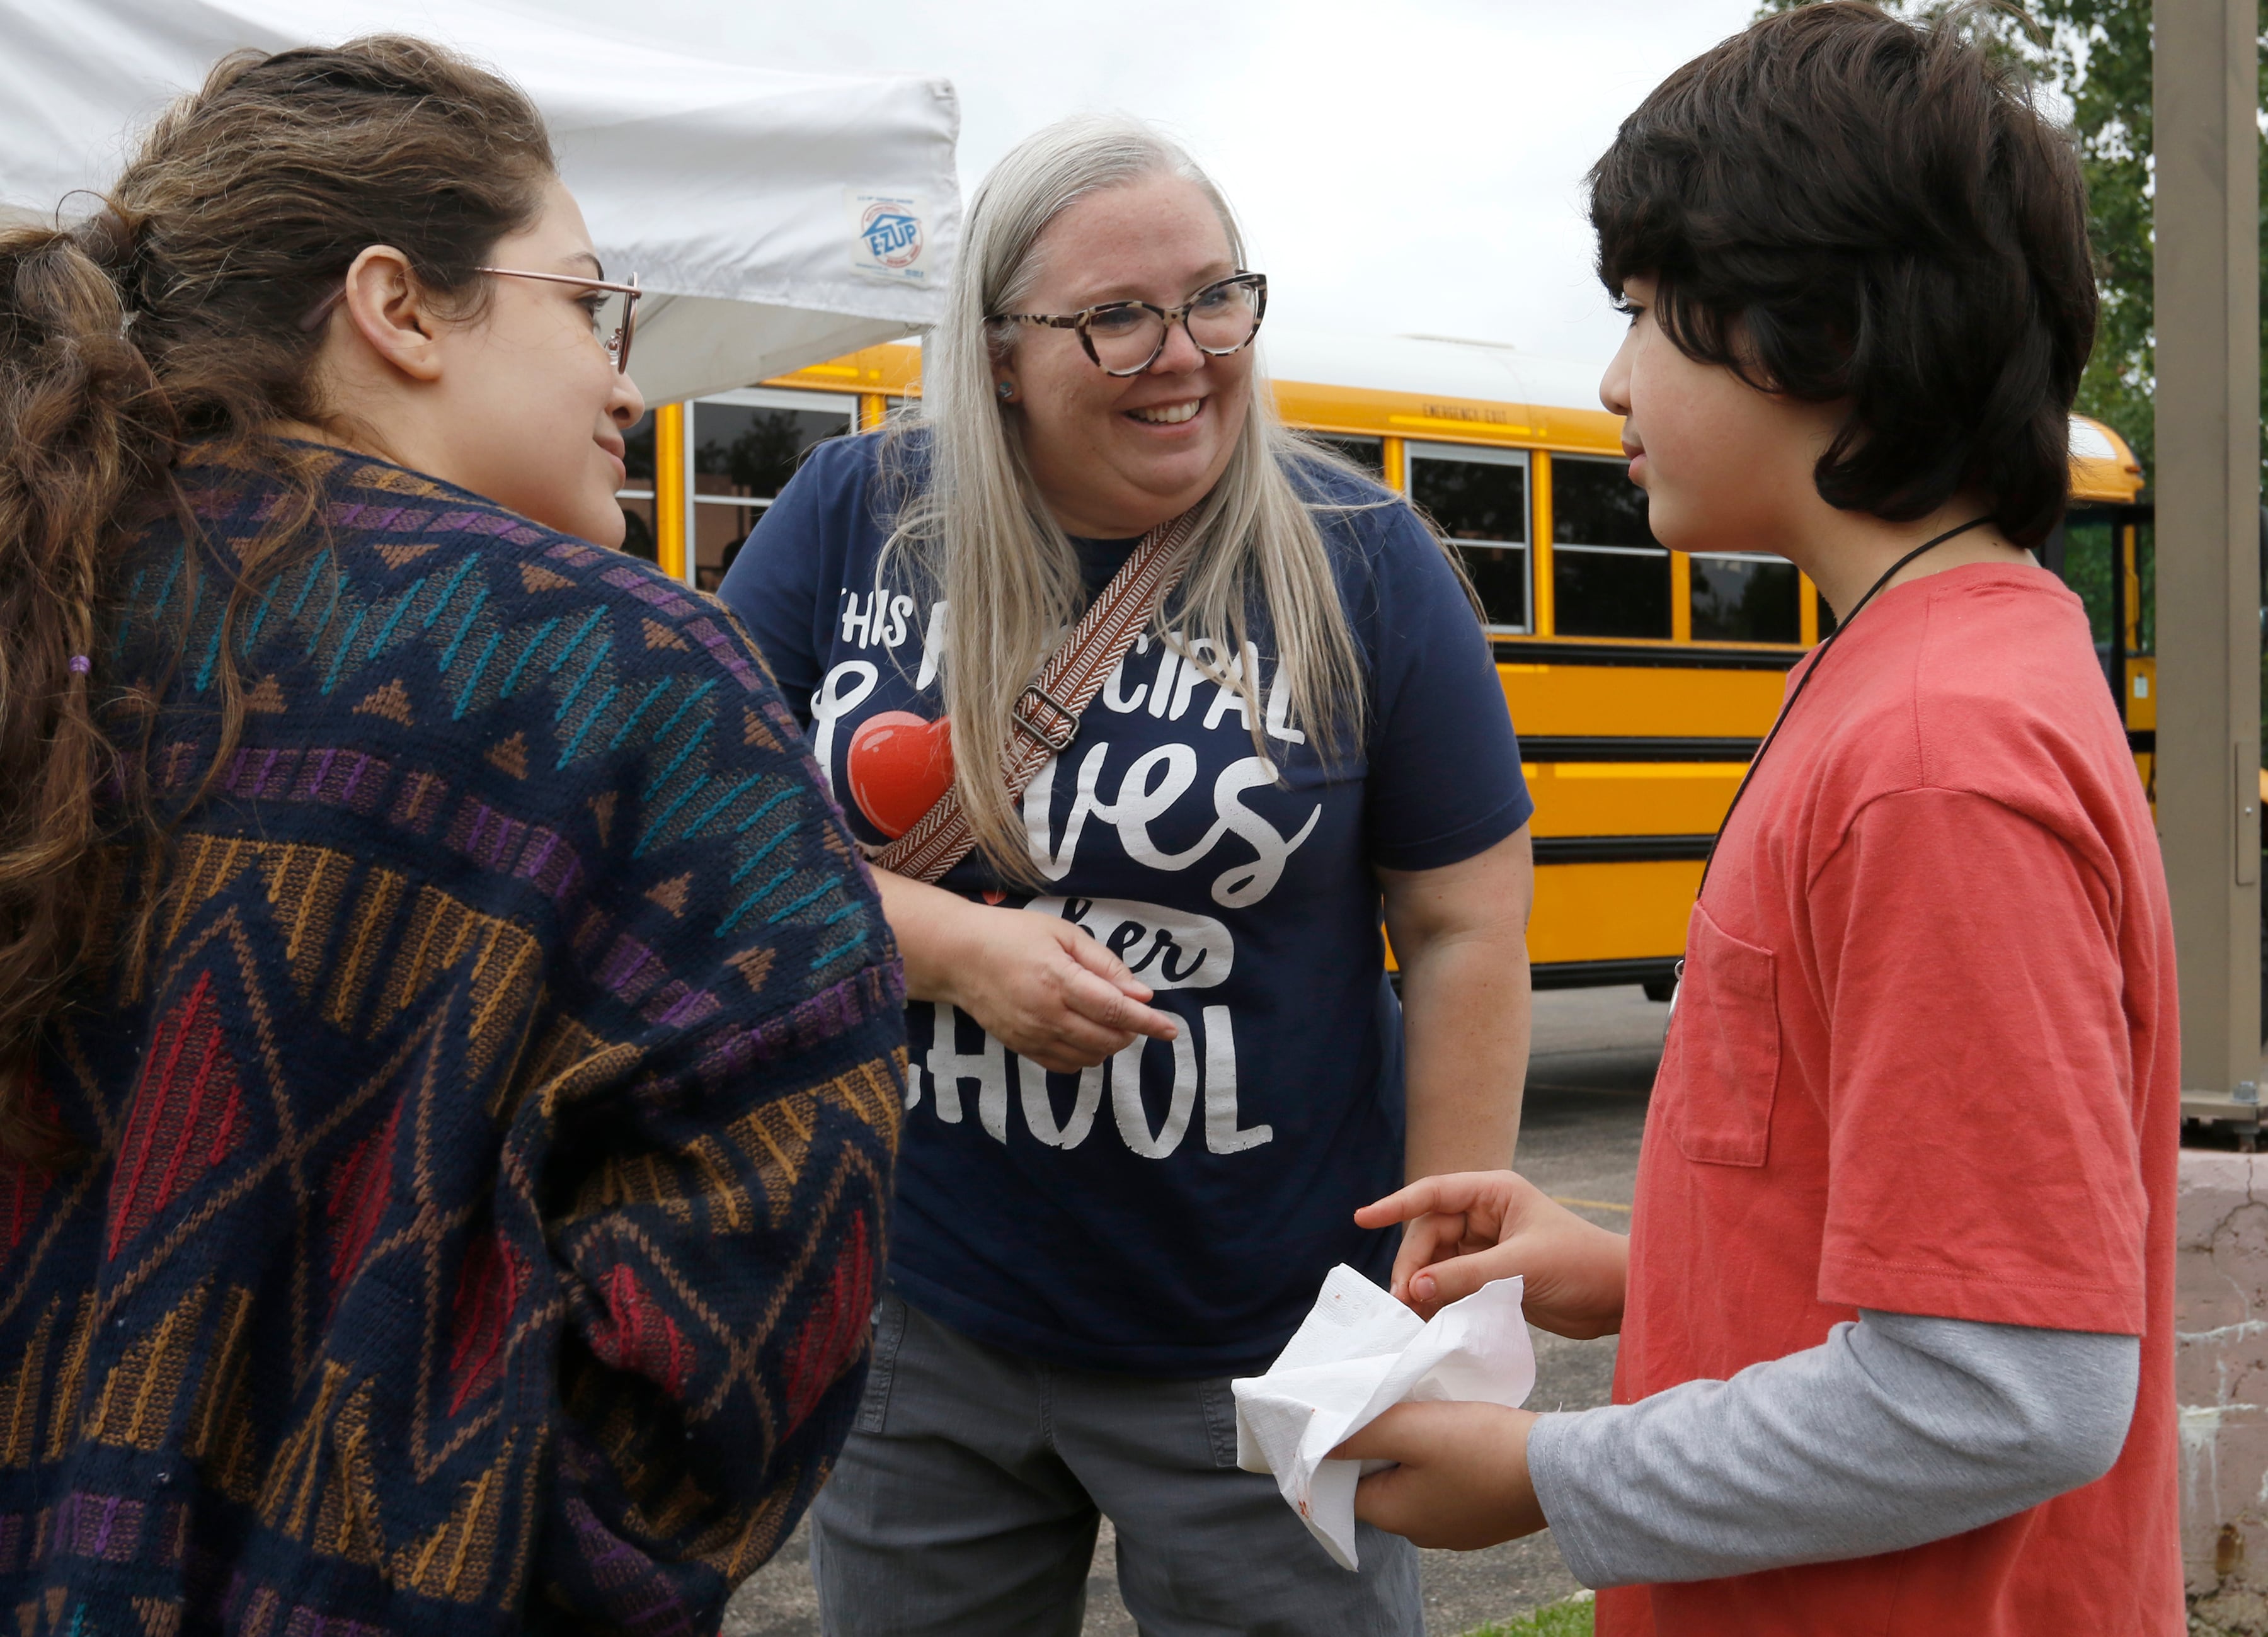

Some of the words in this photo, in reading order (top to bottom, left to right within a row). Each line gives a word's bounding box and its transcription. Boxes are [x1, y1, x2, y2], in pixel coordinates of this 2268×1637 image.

[840, 588, 914, 649] HIS
[916, 600, 1305, 746] CIPAL
[906, 1001, 1273, 1160] HOOL
